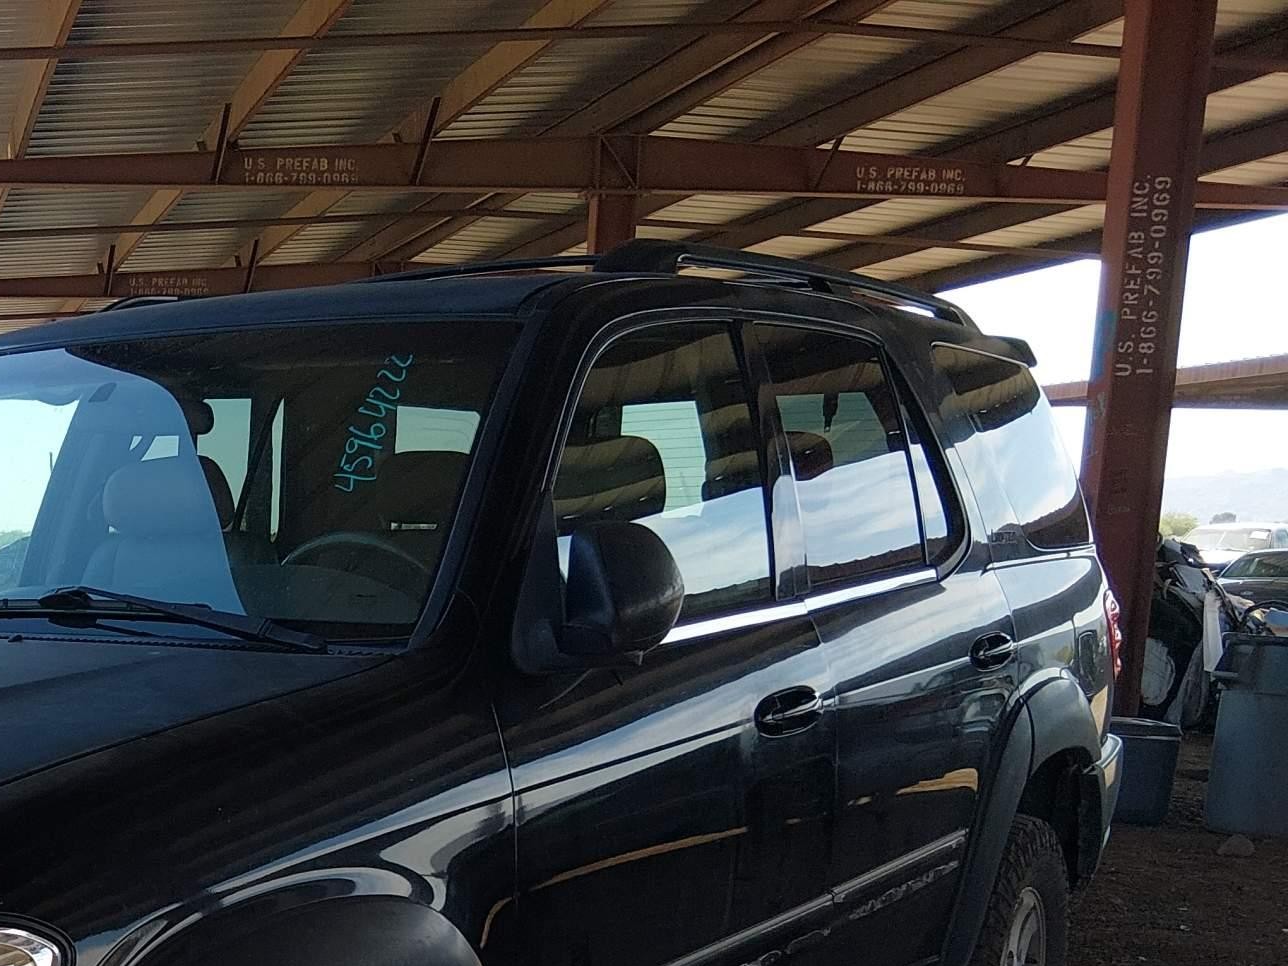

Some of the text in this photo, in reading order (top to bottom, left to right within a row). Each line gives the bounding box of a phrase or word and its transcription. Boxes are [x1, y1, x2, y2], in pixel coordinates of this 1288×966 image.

[276, 157, 329, 171] PREFAB
[856, 180, 965, 194] 1-866-799-0969
[886, 167, 936, 180] PREFAB
[942, 168, 966, 182] INC.
[1115, 175, 1151, 377] U.S. PREFAB INC.
[1136, 176, 1172, 375] 1-866-799-0969
[333, 354, 413, 492] 45964222
